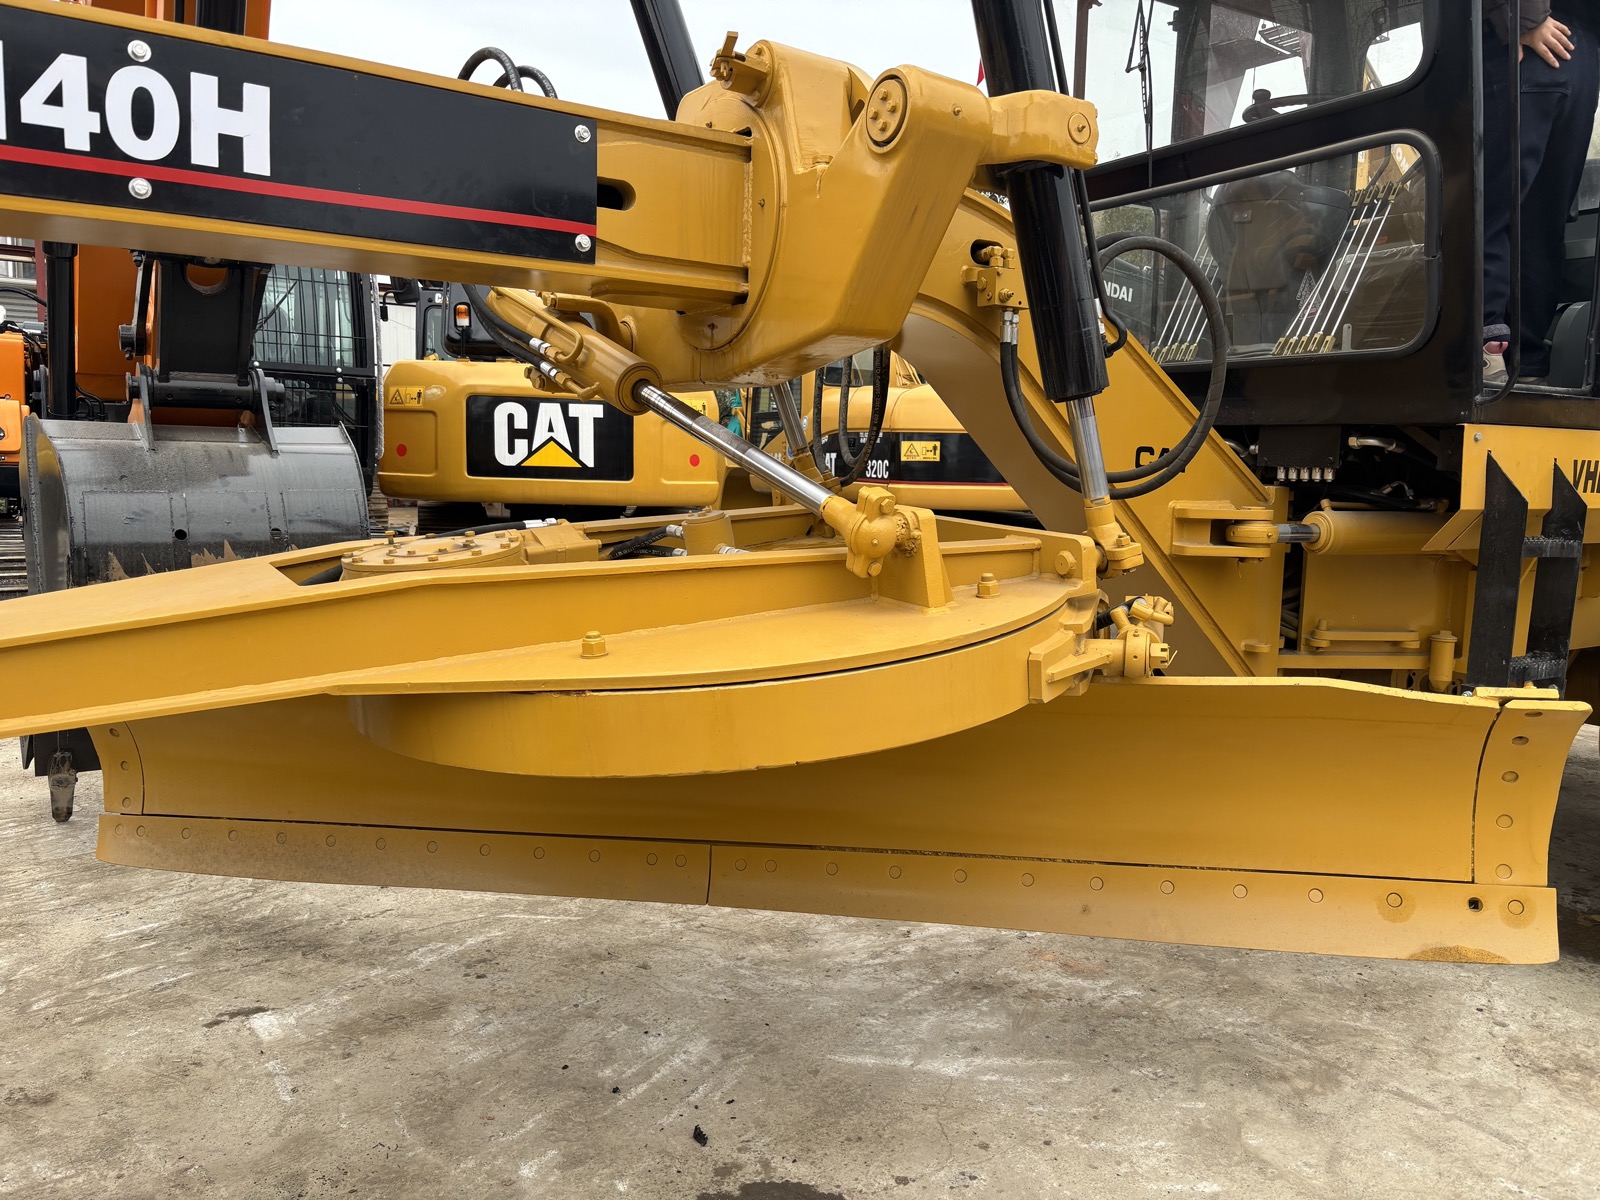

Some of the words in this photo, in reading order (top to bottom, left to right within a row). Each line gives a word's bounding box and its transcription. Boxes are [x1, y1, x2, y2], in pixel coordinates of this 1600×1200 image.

[0, 40, 271, 176] 40H
[493, 401, 604, 468] CAT
[822, 452, 837, 477] AT
[865, 459, 889, 479] 320C
[1572, 459, 1600, 494] VH
